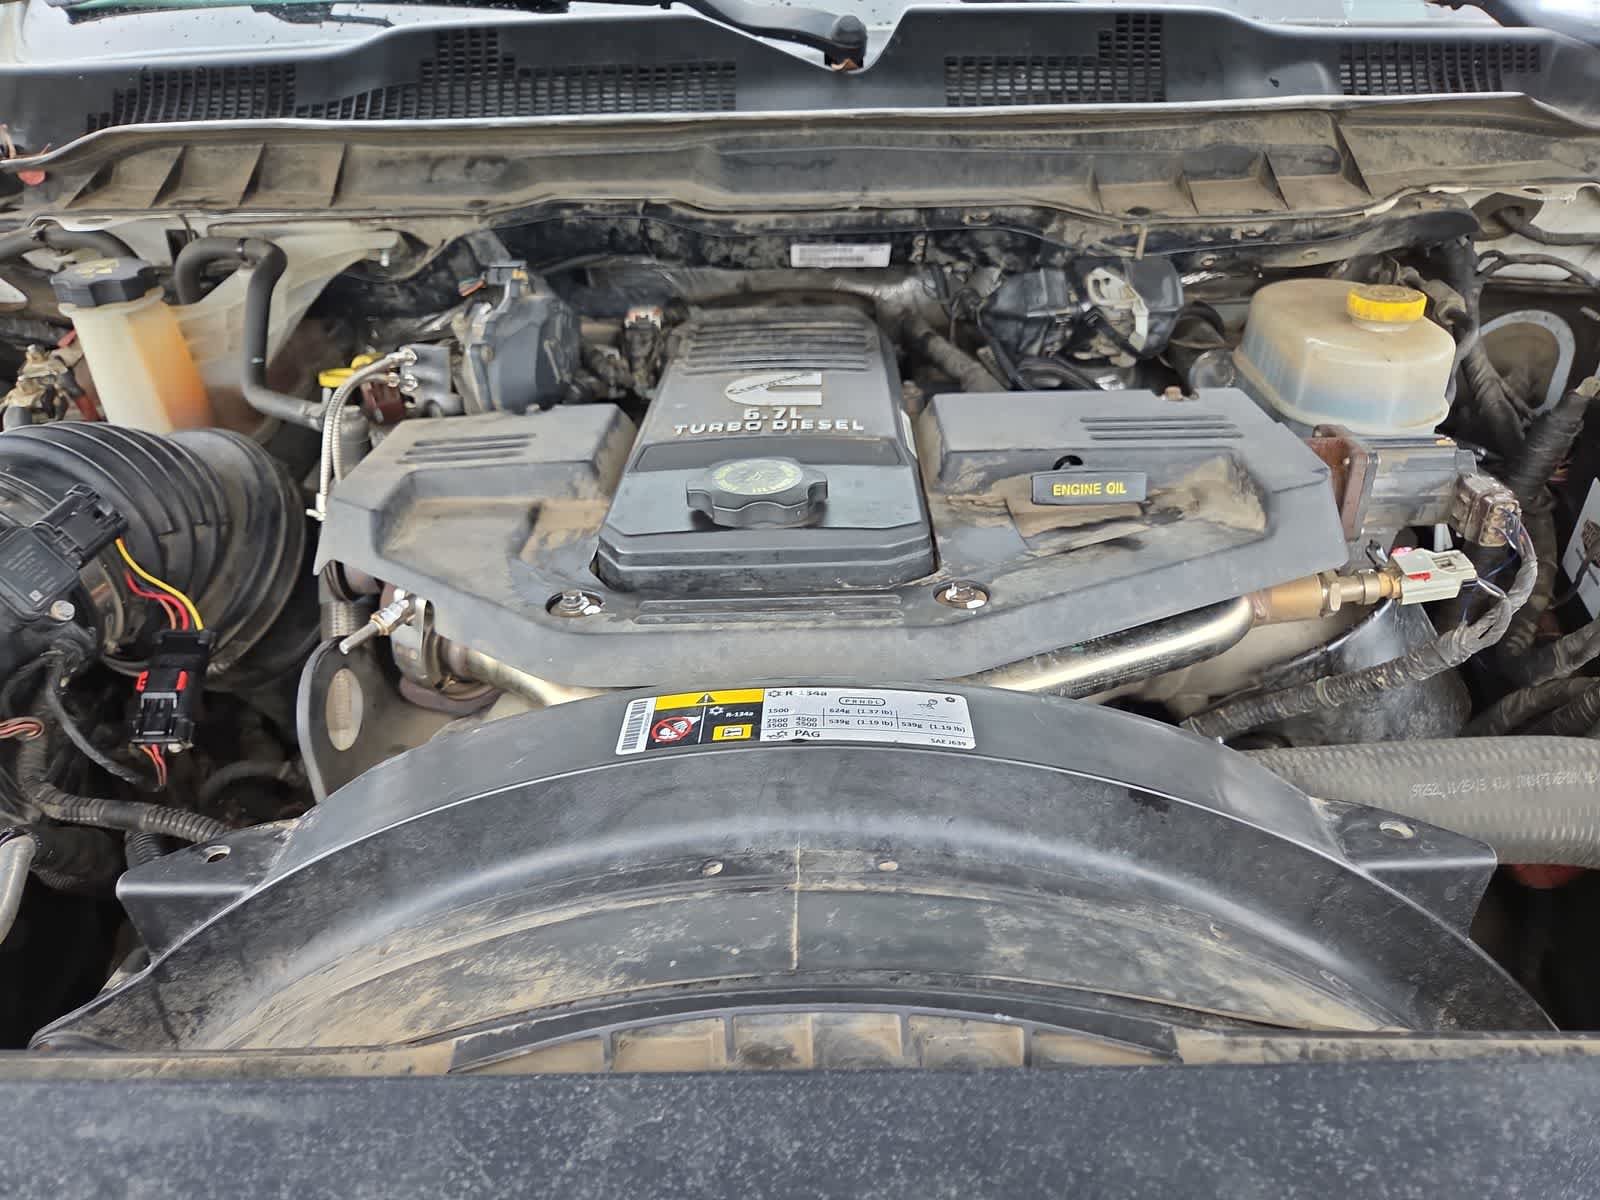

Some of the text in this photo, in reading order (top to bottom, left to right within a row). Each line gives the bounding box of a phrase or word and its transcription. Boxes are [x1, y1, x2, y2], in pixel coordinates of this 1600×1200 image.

[744, 407, 803, 421] 6.7L
[674, 418, 865, 435] TURBO DIESEL
[1052, 481, 1127, 496] ENGINE OIL
[881, 709, 893, 717] lb)
[881, 720, 894, 728] lb)
[902, 721, 923, 729] 539g
[953, 724, 966, 733] lb)
[794, 729, 821, 737] PAG
